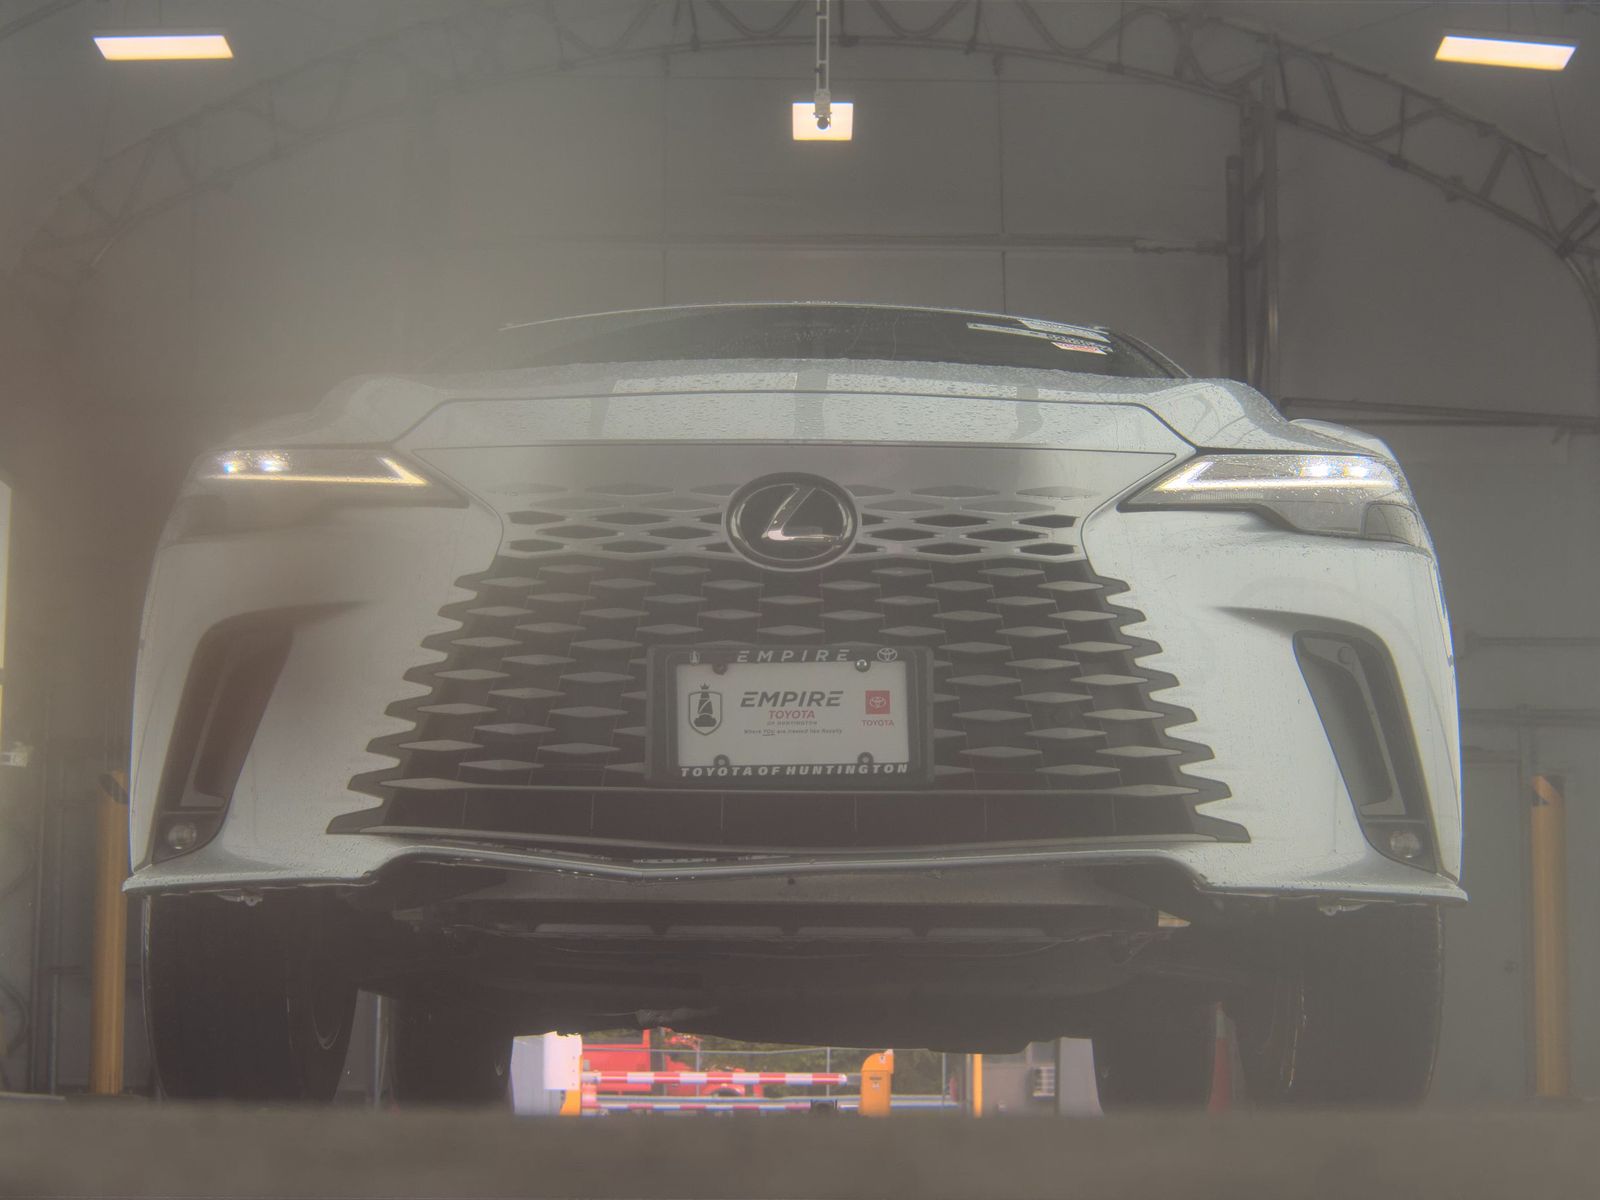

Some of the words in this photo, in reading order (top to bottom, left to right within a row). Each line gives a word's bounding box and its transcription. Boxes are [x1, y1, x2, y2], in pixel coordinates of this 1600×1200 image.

[737, 650, 849, 663] EMPIRE
[740, 690, 844, 708] EMPIRE
[768, 710, 816, 720] TOYOTA
[861, 719, 895, 727] TOYOTA
[681, 766, 752, 777] TOYOTA
[758, 765, 781, 776] OF
[786, 764, 908, 776] HUNTINGTON
